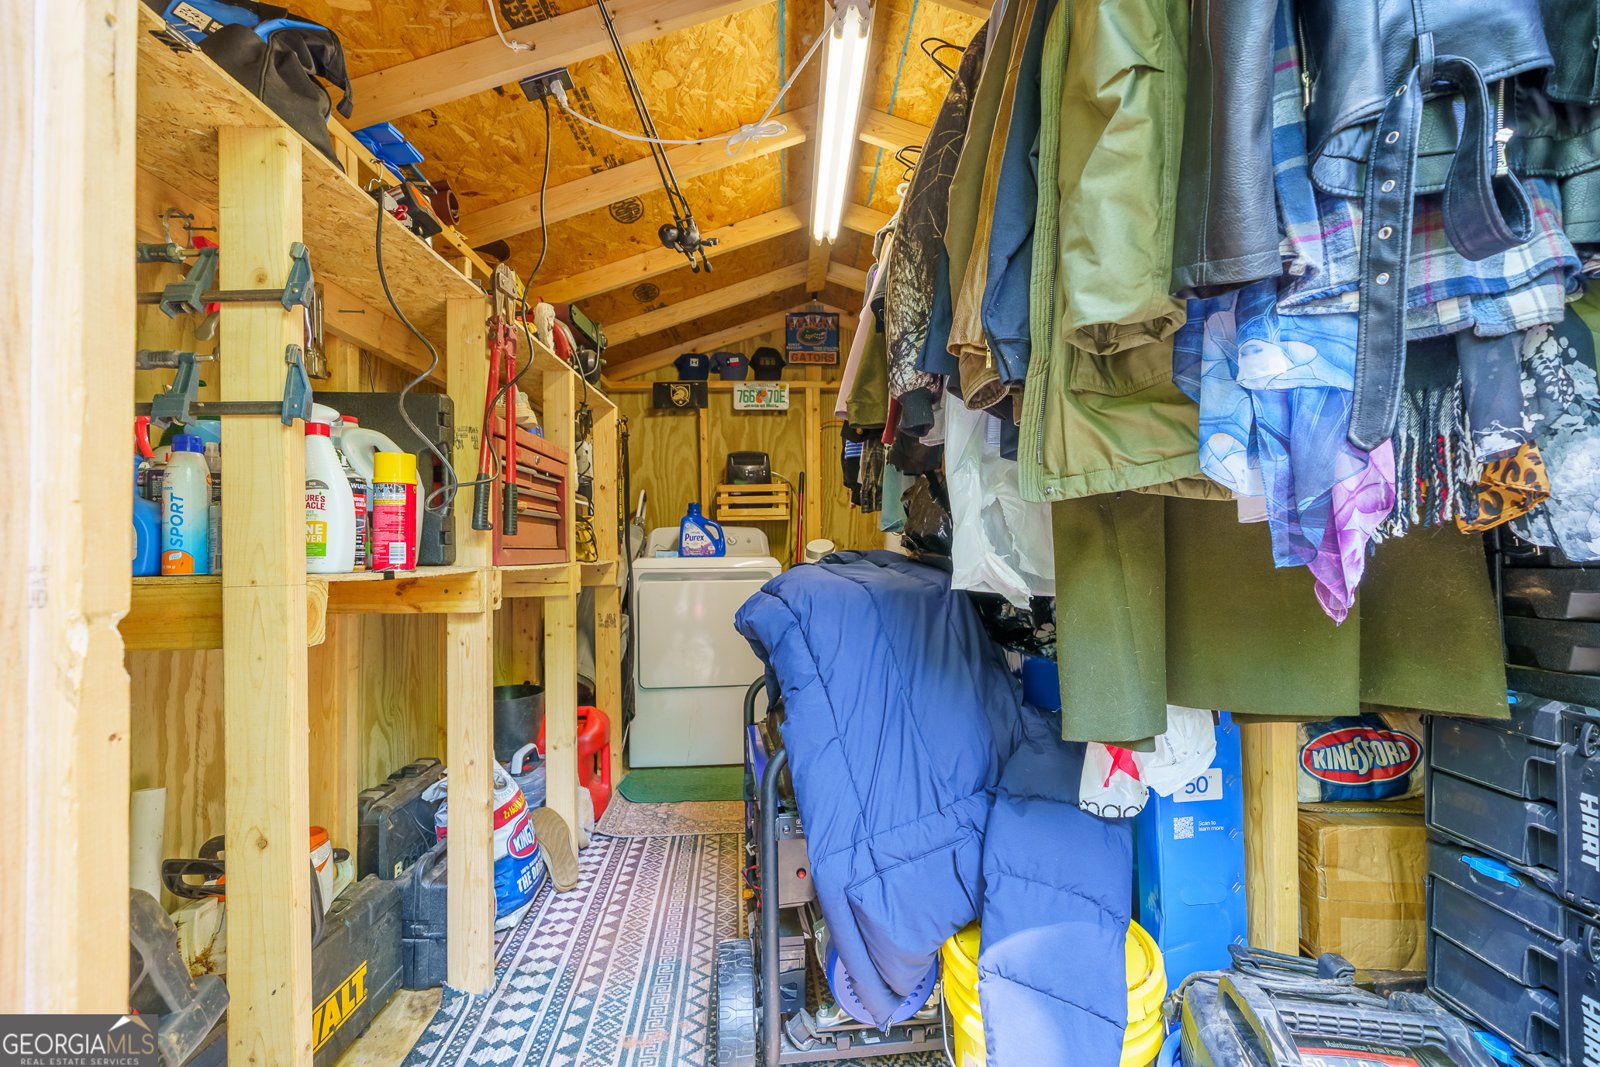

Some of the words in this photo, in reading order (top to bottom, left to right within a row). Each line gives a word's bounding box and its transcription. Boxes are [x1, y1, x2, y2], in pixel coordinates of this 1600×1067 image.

[791, 352, 834, 362] GATORS
[737, 389, 755, 403] 766
[170, 492, 184, 547] SPORT
[684, 533, 704, 542] Purex
[1312, 736, 1411, 776] KINGSFORD
[1579, 791, 1600, 873] HART
[517, 873, 533, 893] THE
[1385, 1047, 1406, 1057] Pump
